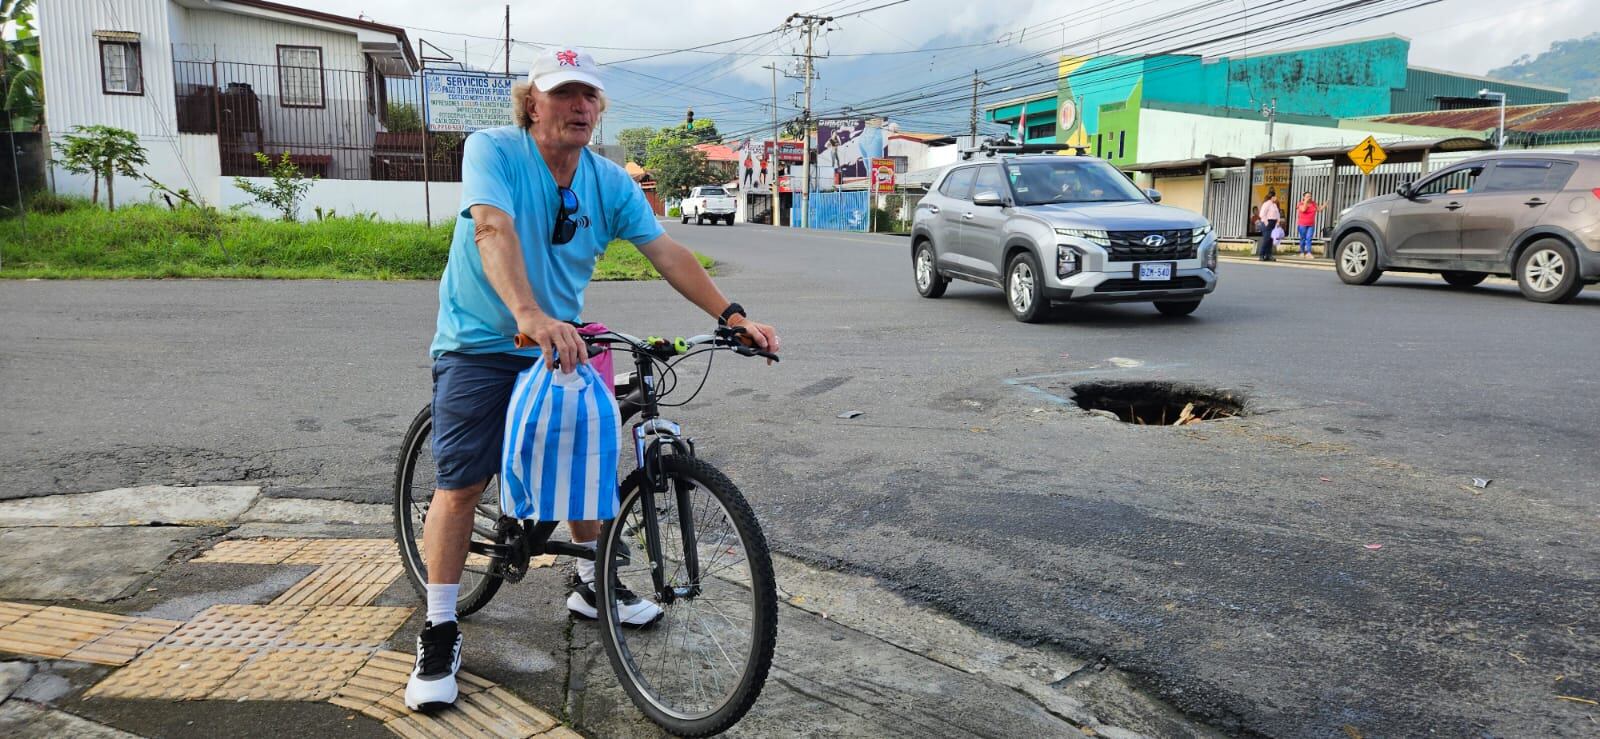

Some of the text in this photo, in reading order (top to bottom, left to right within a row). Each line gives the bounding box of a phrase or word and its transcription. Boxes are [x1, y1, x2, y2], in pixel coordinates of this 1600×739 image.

[446, 76, 489, 87] SERVICIOS
[492, 79, 511, 88] J&M
[457, 86, 464, 95] DE
[464, 87, 491, 95] SERVICIOS
